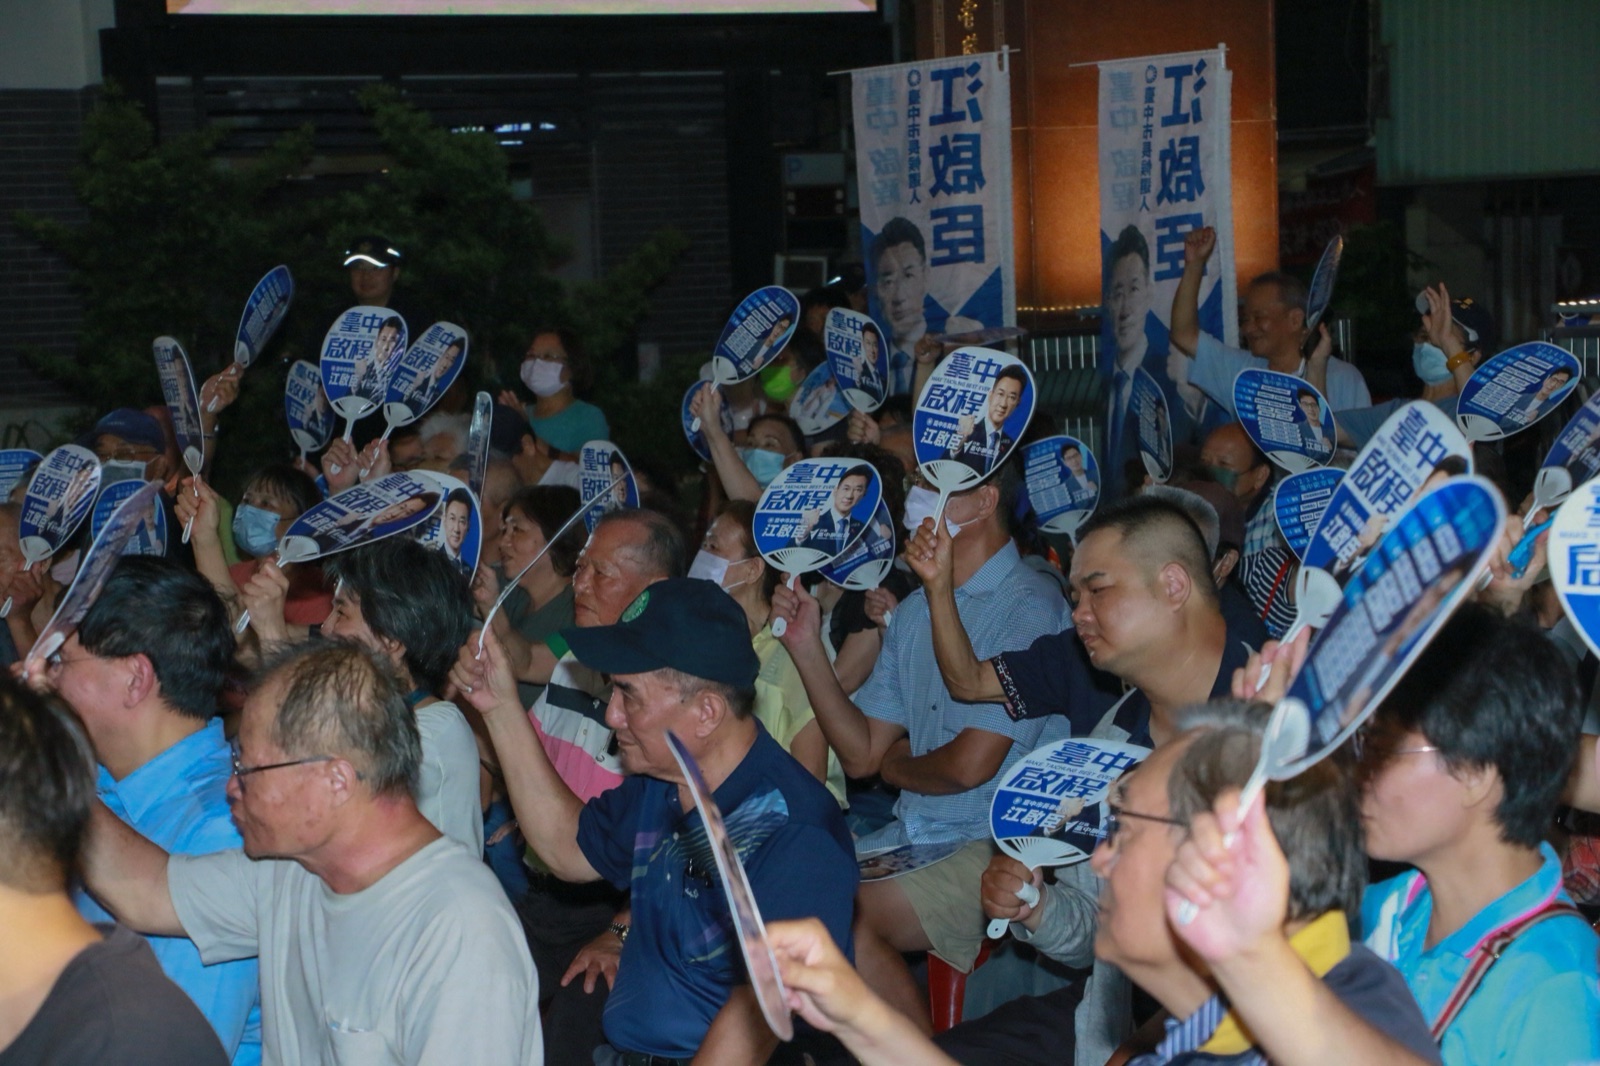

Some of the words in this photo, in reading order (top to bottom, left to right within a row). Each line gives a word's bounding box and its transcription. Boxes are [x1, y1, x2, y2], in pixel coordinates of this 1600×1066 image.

[339, 311, 384, 334] 臺中
[832, 310, 863, 334] 臺中
[324, 337, 374, 361] 啟程
[424, 325, 457, 349] 臺中
[827, 331, 862, 358] 啟程
[402, 346, 440, 373] 啟程
[944, 352, 1003, 384] 臺中
[921, 383, 987, 419] 啟程
[920, 427, 963, 451] 江啟臣
[1390, 405, 1448, 470] 臺中
[48, 448, 85, 474] 臺中
[583, 448, 610, 472] 臺中
[375, 471, 426, 498] 臺中
[784, 463, 848, 484] 臺中
[1350, 447, 1414, 515] 啟程
[29, 473, 70, 501] 啟程
[332, 487, 391, 517] 啟程
[760, 490, 832, 511] 啟程
[762, 524, 808, 538] 江啟臣
[1024, 759, 1044, 767] MAKE
[1046, 741, 1137, 773] 臺中
[1006, 766, 1108, 801] 啟程
[1001, 806, 1066, 830] 江啟臣
